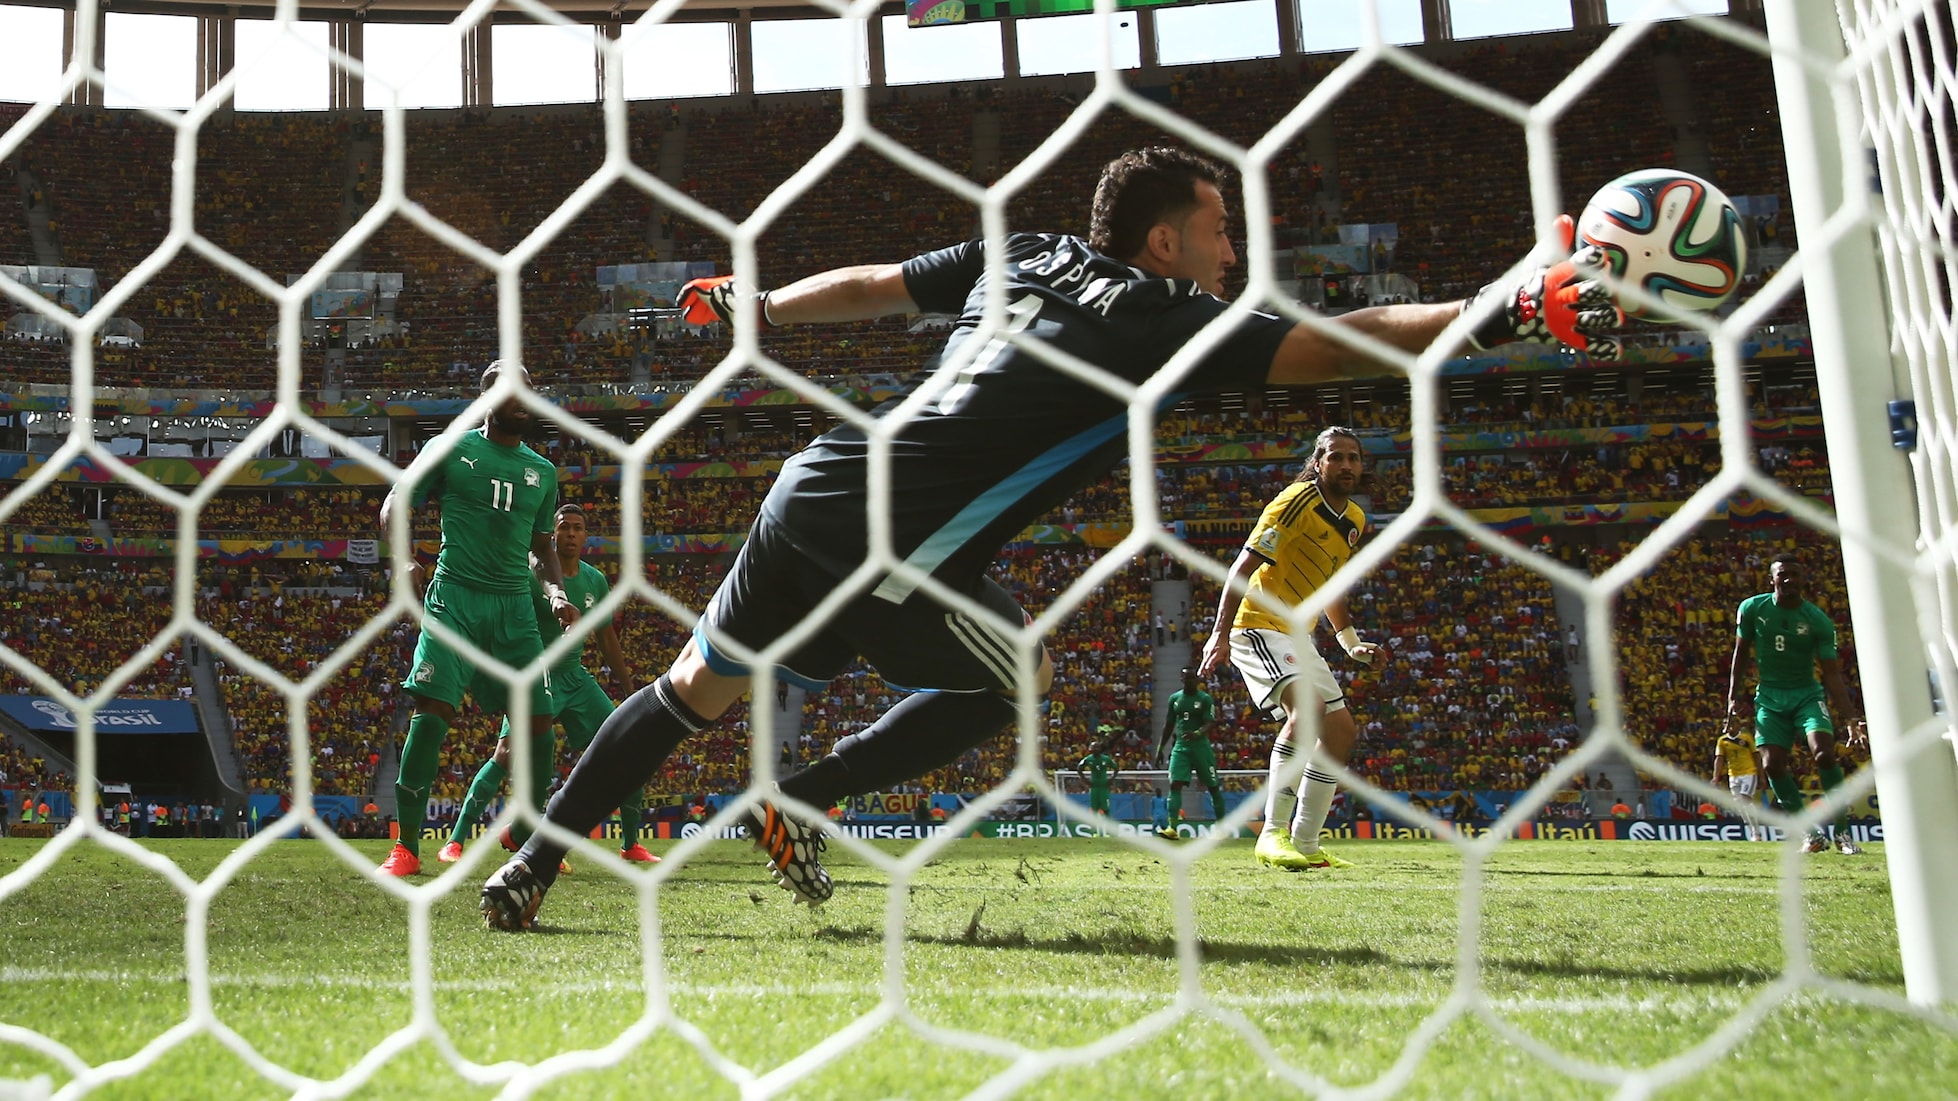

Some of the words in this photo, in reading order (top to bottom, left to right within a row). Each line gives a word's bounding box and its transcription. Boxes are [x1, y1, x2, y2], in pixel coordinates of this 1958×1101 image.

[490, 478, 514, 512] 11
[1775, 635, 1785, 651] 8
[606, 823, 654, 839] Itú
[1375, 823, 1432, 839] Itaú
[1536, 822, 1596, 840] Itaú
